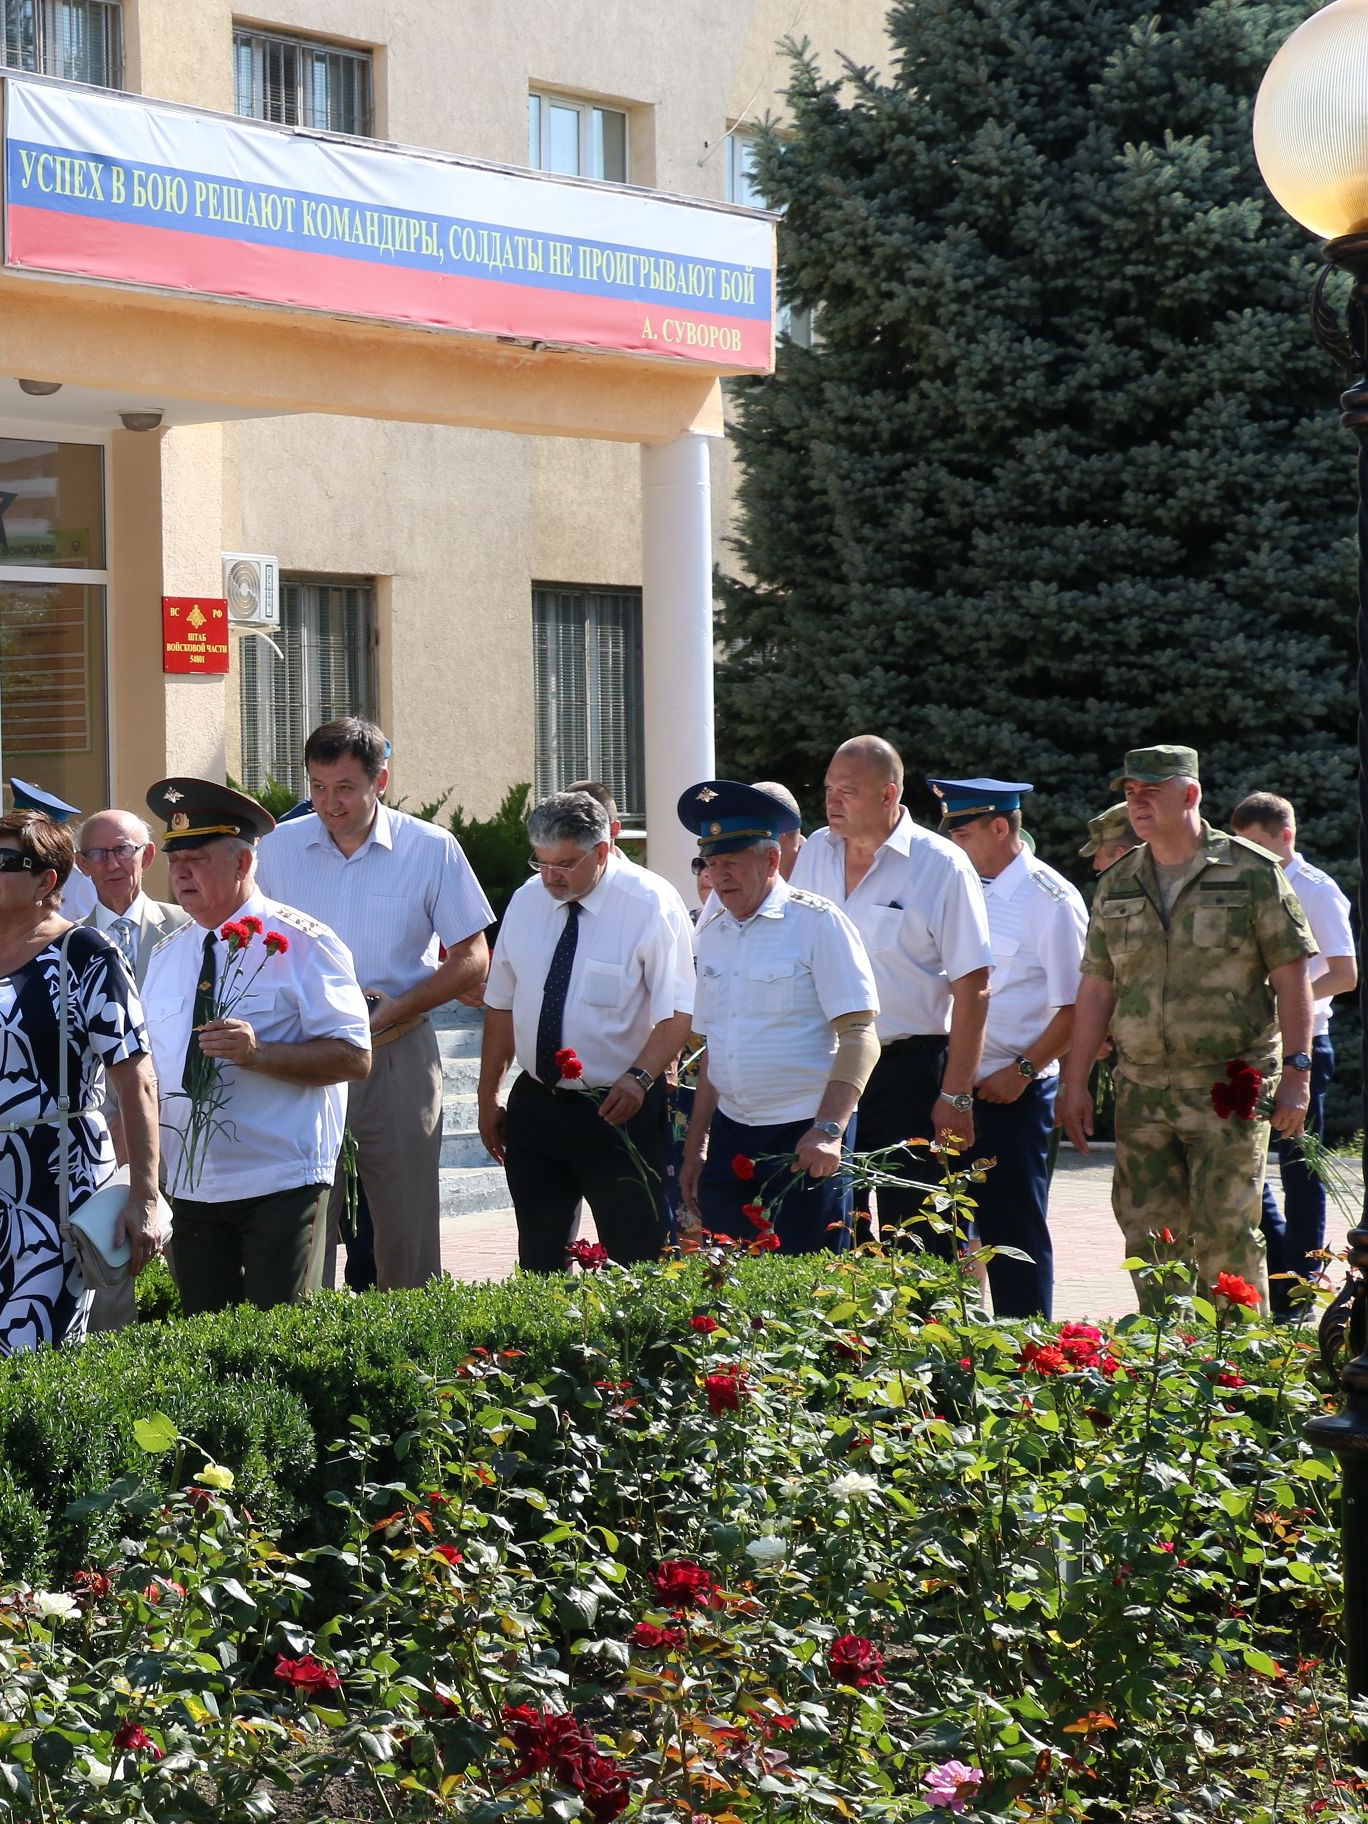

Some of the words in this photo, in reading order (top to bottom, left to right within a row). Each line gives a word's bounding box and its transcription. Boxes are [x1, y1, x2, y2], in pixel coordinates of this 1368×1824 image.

[19, 148, 104, 201] УСПЕХ
[111, 165, 126, 204] В
[132, 169, 189, 215] БОЮ
[194, 179, 296, 233] РЕШАЮТ
[301, 198, 444, 265] КОМАНДИРЫ,
[448, 223, 544, 275] СОЛДАТЫ
[548, 240, 574, 277] НЕ
[578, 245, 716, 299] ПРОИГРЫВАЮТ
[720, 264, 756, 305] БОЙ
[640, 317, 658, 341] А.
[661, 318, 743, 352] СУВОРОВ
[170, 607, 180, 617] ВС
[212, 609, 223, 618] РФ
[187, 632, 207, 642] ШТАБ
[166, 642, 206, 653] ВОЙСКОВОЙ
[206, 644, 228, 653] ЧАСТИ
